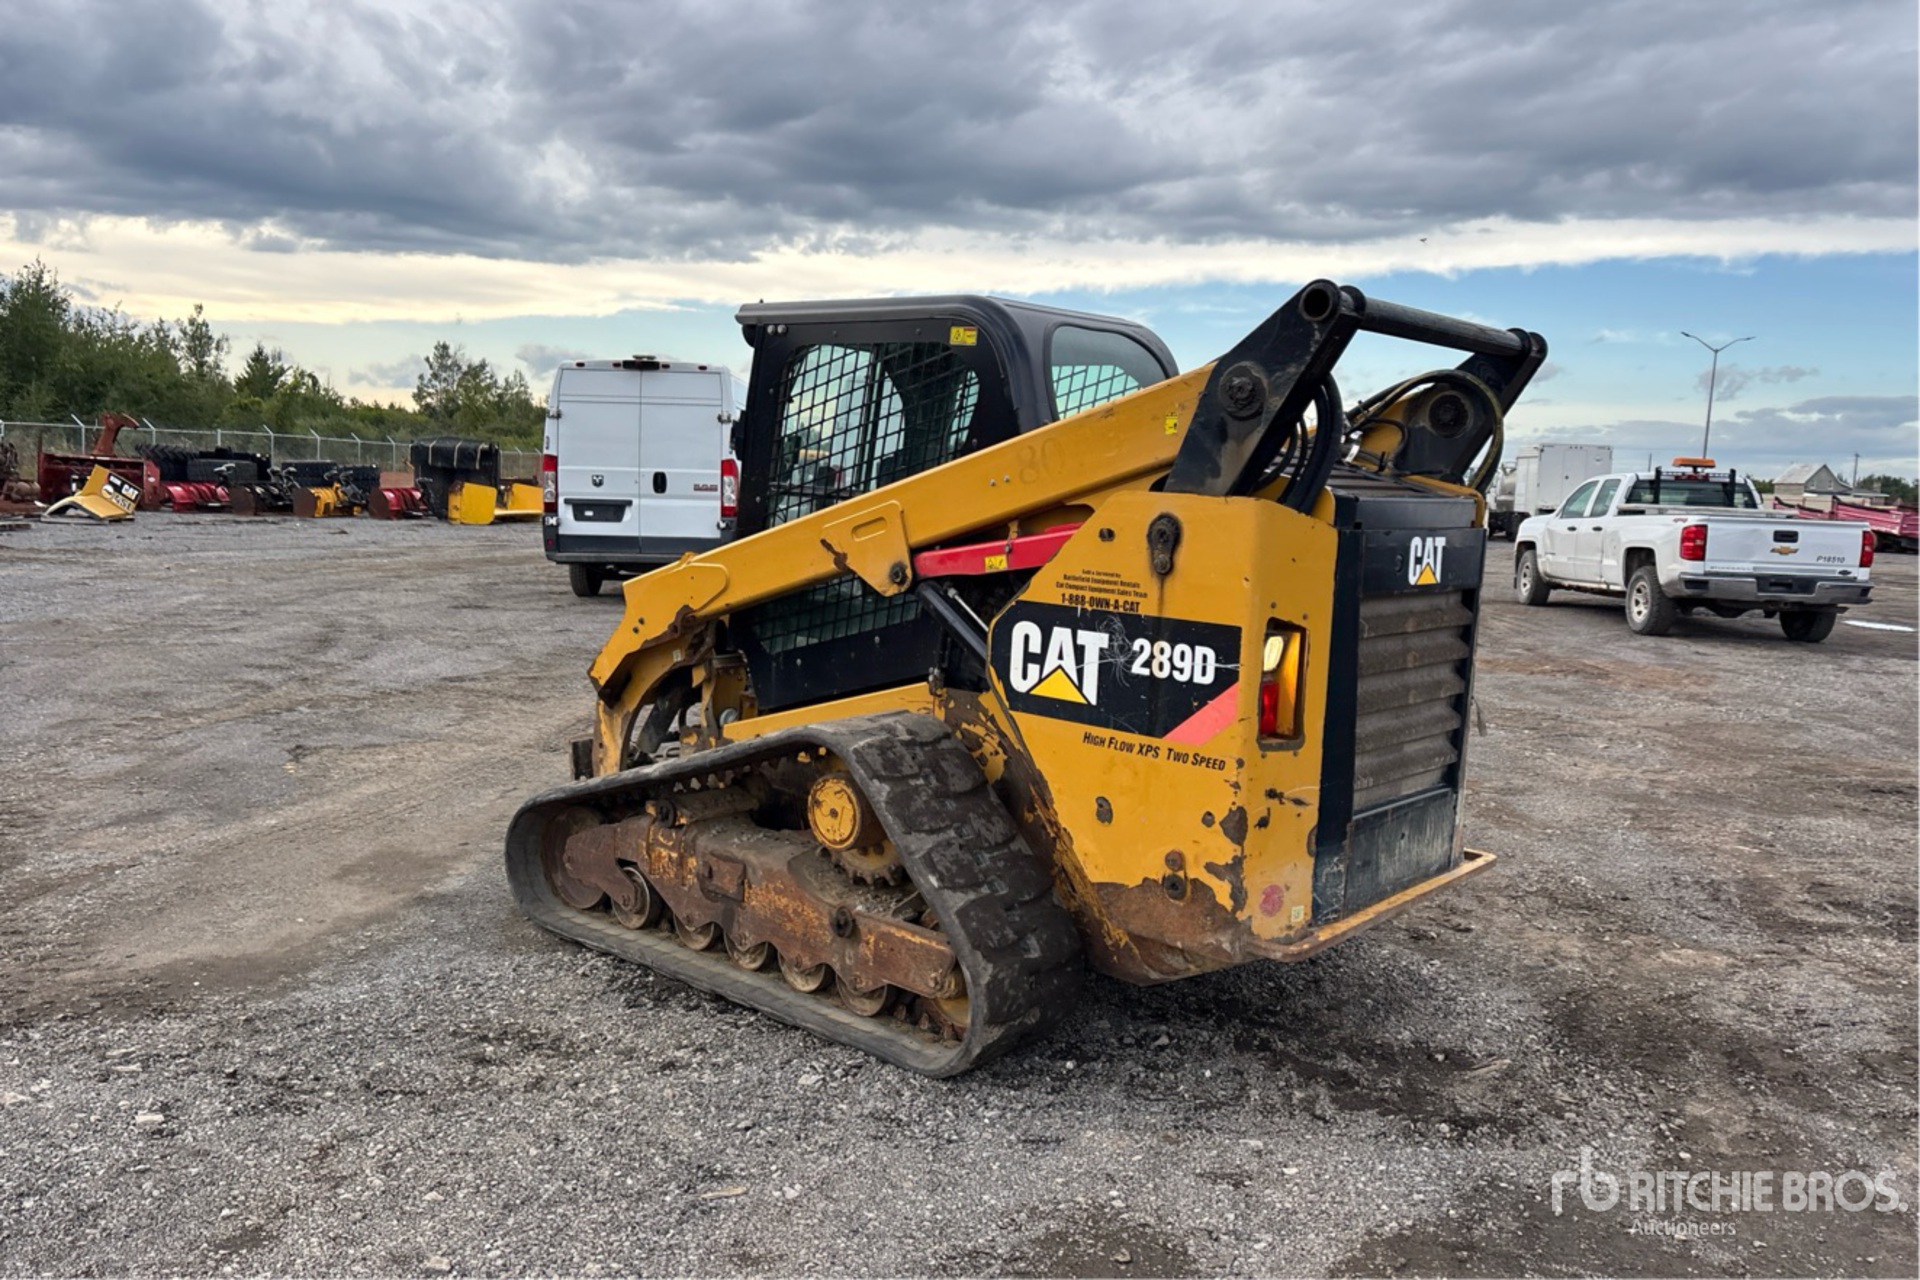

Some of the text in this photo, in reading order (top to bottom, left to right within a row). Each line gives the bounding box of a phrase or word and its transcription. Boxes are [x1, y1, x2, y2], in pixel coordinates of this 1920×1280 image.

[1408, 536, 1446, 585] CAT
[1088, 584, 1116, 594] Equipment
[1117, 587, 1131, 597] Sales
[1091, 577, 1119, 585] Equipment
[1120, 580, 1141, 588] Rentals
[1061, 592, 1140, 612] 1-888-OWN-A-CAT
[1009, 620, 1216, 706] CAT 289D
[1136, 742, 1160, 759] XPS
